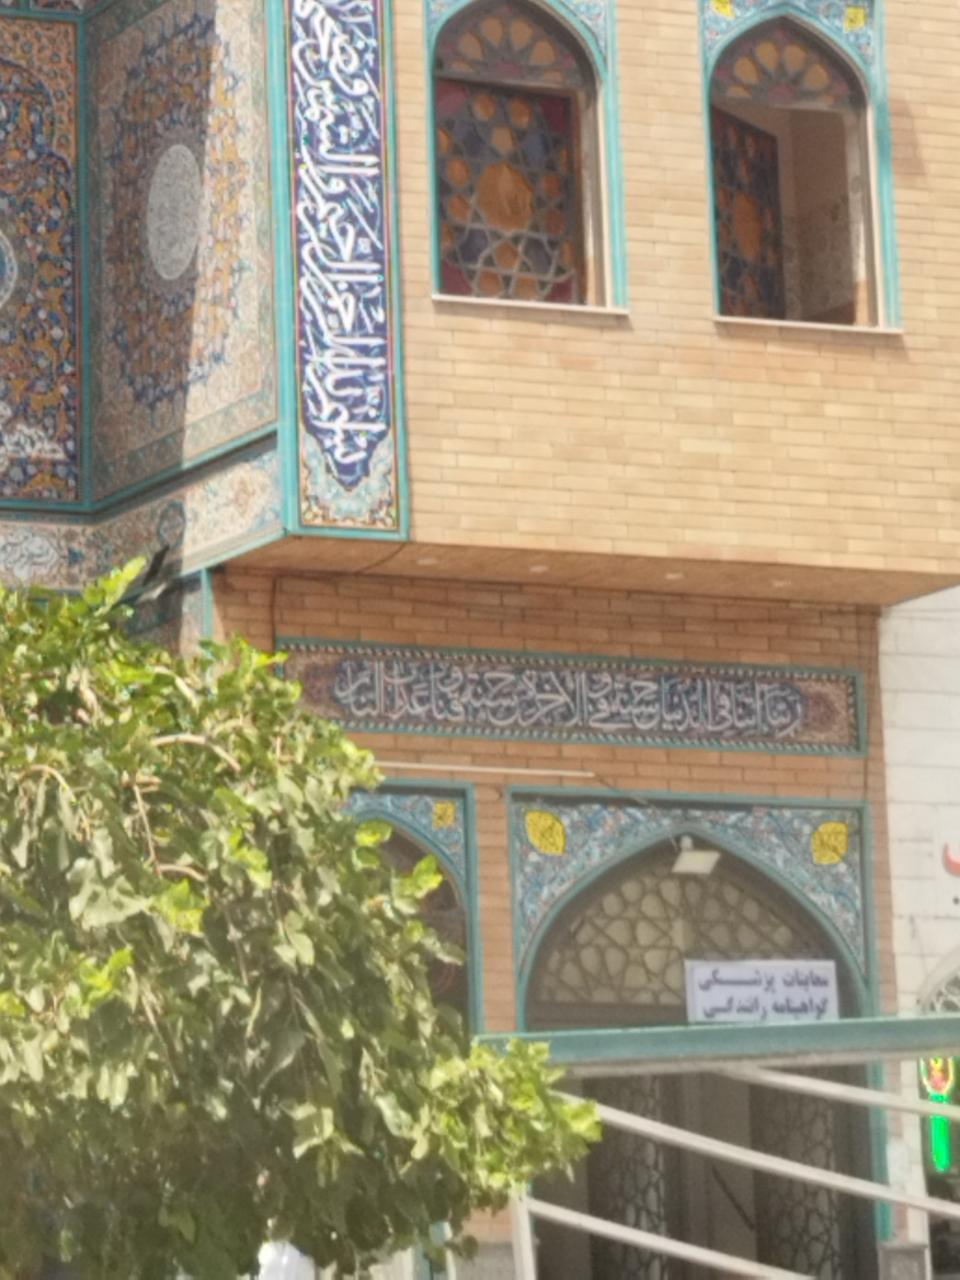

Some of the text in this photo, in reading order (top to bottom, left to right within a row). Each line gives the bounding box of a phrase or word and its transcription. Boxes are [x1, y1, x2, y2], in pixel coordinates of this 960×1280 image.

[698, 968, 830, 994] معاینات پزشکی
[702, 996, 768, 1019] رانندگی
